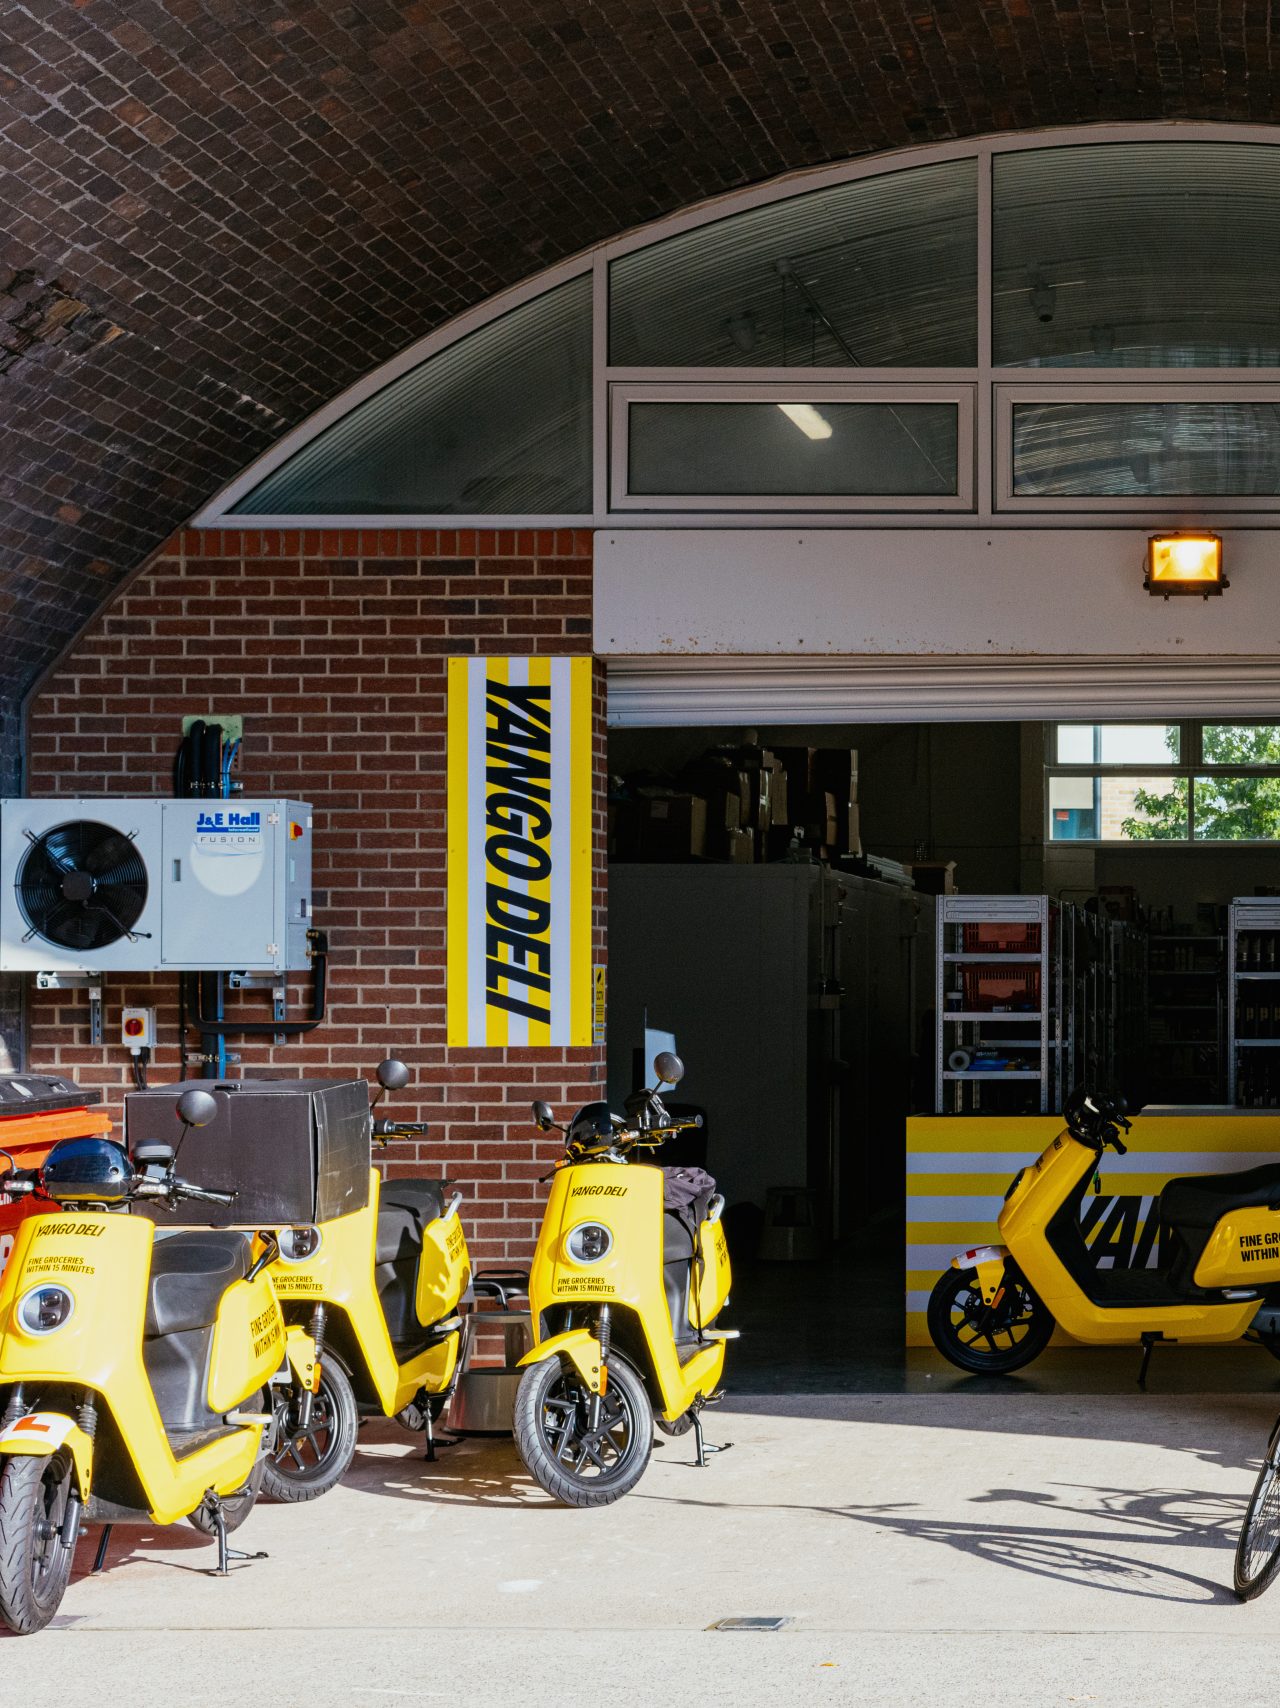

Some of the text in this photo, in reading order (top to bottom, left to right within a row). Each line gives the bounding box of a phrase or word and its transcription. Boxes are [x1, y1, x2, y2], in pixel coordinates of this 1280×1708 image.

[197, 812, 260, 827] J&E Hall
[485, 679, 552, 1024] YANGO DELI
[571, 1185, 628, 1197] YANGO DELI
[36, 1223, 106, 1237] YANGO DELI
[1239, 1234, 1262, 1247] FINE
[1240, 1247, 1279, 1262] WITHIN
[28, 1256, 84, 1266] FINE GROCERIES
[26, 1264, 50, 1273] WITHIN
[60, 1264, 95, 1275] MINUTES
[295, 1283, 323, 1291] MINUTES
[557, 1285, 578, 1293] WITHIN
[587, 1285, 615, 1293] MINUTES
